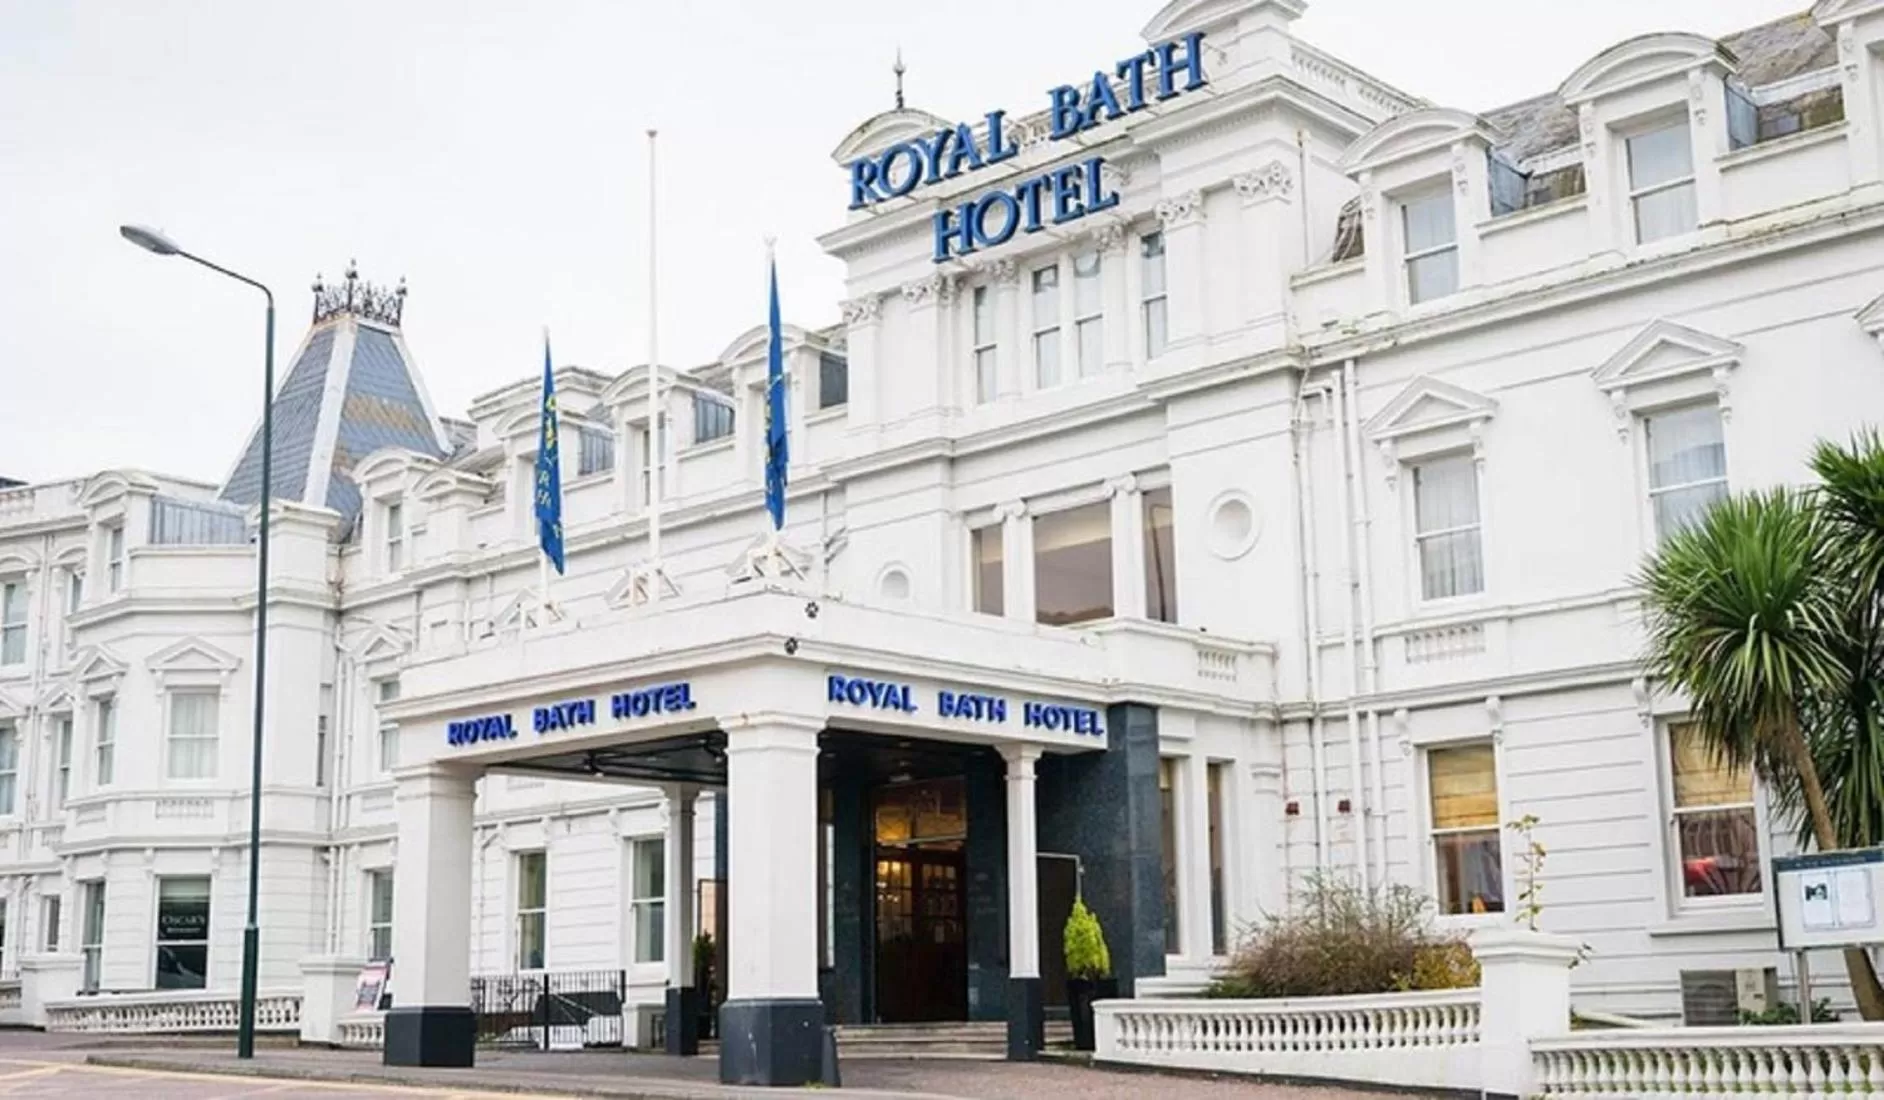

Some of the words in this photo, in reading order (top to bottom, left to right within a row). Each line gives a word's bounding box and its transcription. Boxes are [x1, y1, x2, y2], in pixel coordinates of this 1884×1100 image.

[849, 109, 1018, 210] ROYAL
[1048, 32, 1207, 141] BATH
[932, 157, 1120, 263] HOTEL
[447, 714, 518, 746] ROYAL
[533, 699, 596, 733] BATH
[611, 682, 697, 719] HOTEL
[828, 675, 918, 712] ROYAL
[938, 691, 1007, 723] BATH
[1023, 702, 1104, 736] HOTEL
